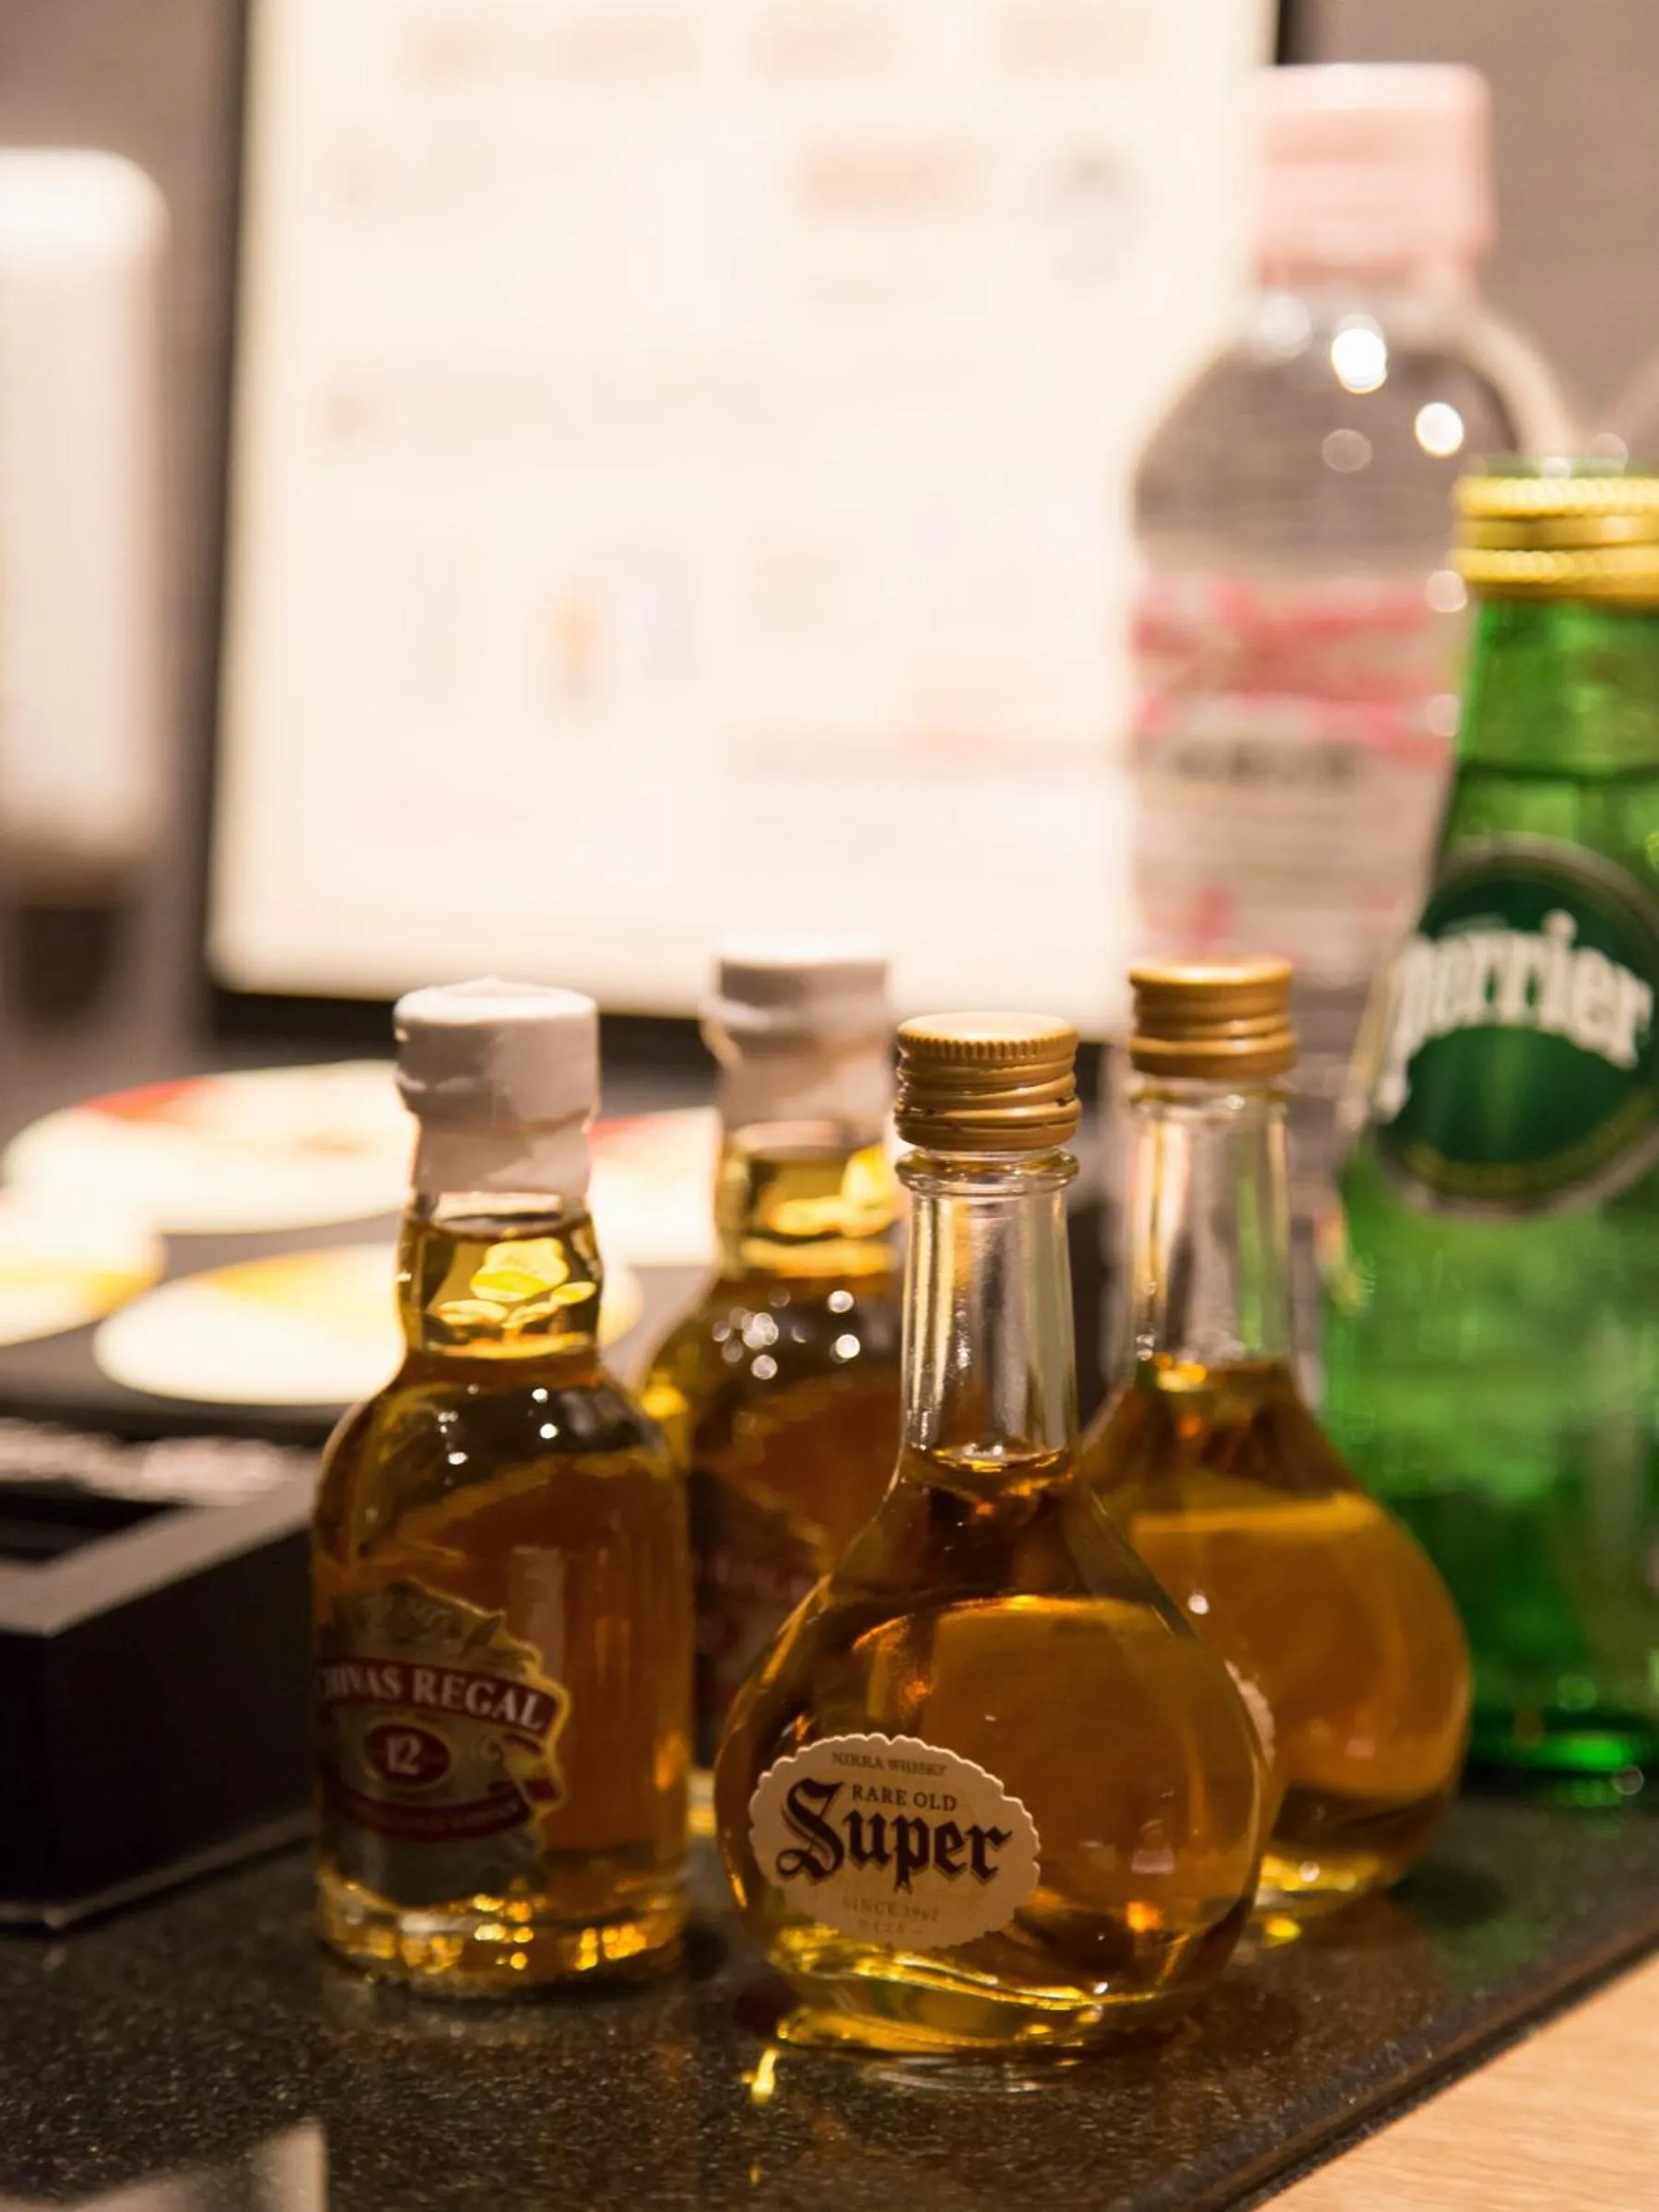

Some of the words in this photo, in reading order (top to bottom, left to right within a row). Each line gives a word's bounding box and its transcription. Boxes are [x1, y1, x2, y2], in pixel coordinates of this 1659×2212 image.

[413, 1668, 544, 1731] REGAL
[384, 1735, 421, 1775] 12
[852, 1783, 908, 1806] RARE
[913, 1792, 958, 1812] OLD
[775, 1778, 1013, 1894] Super
